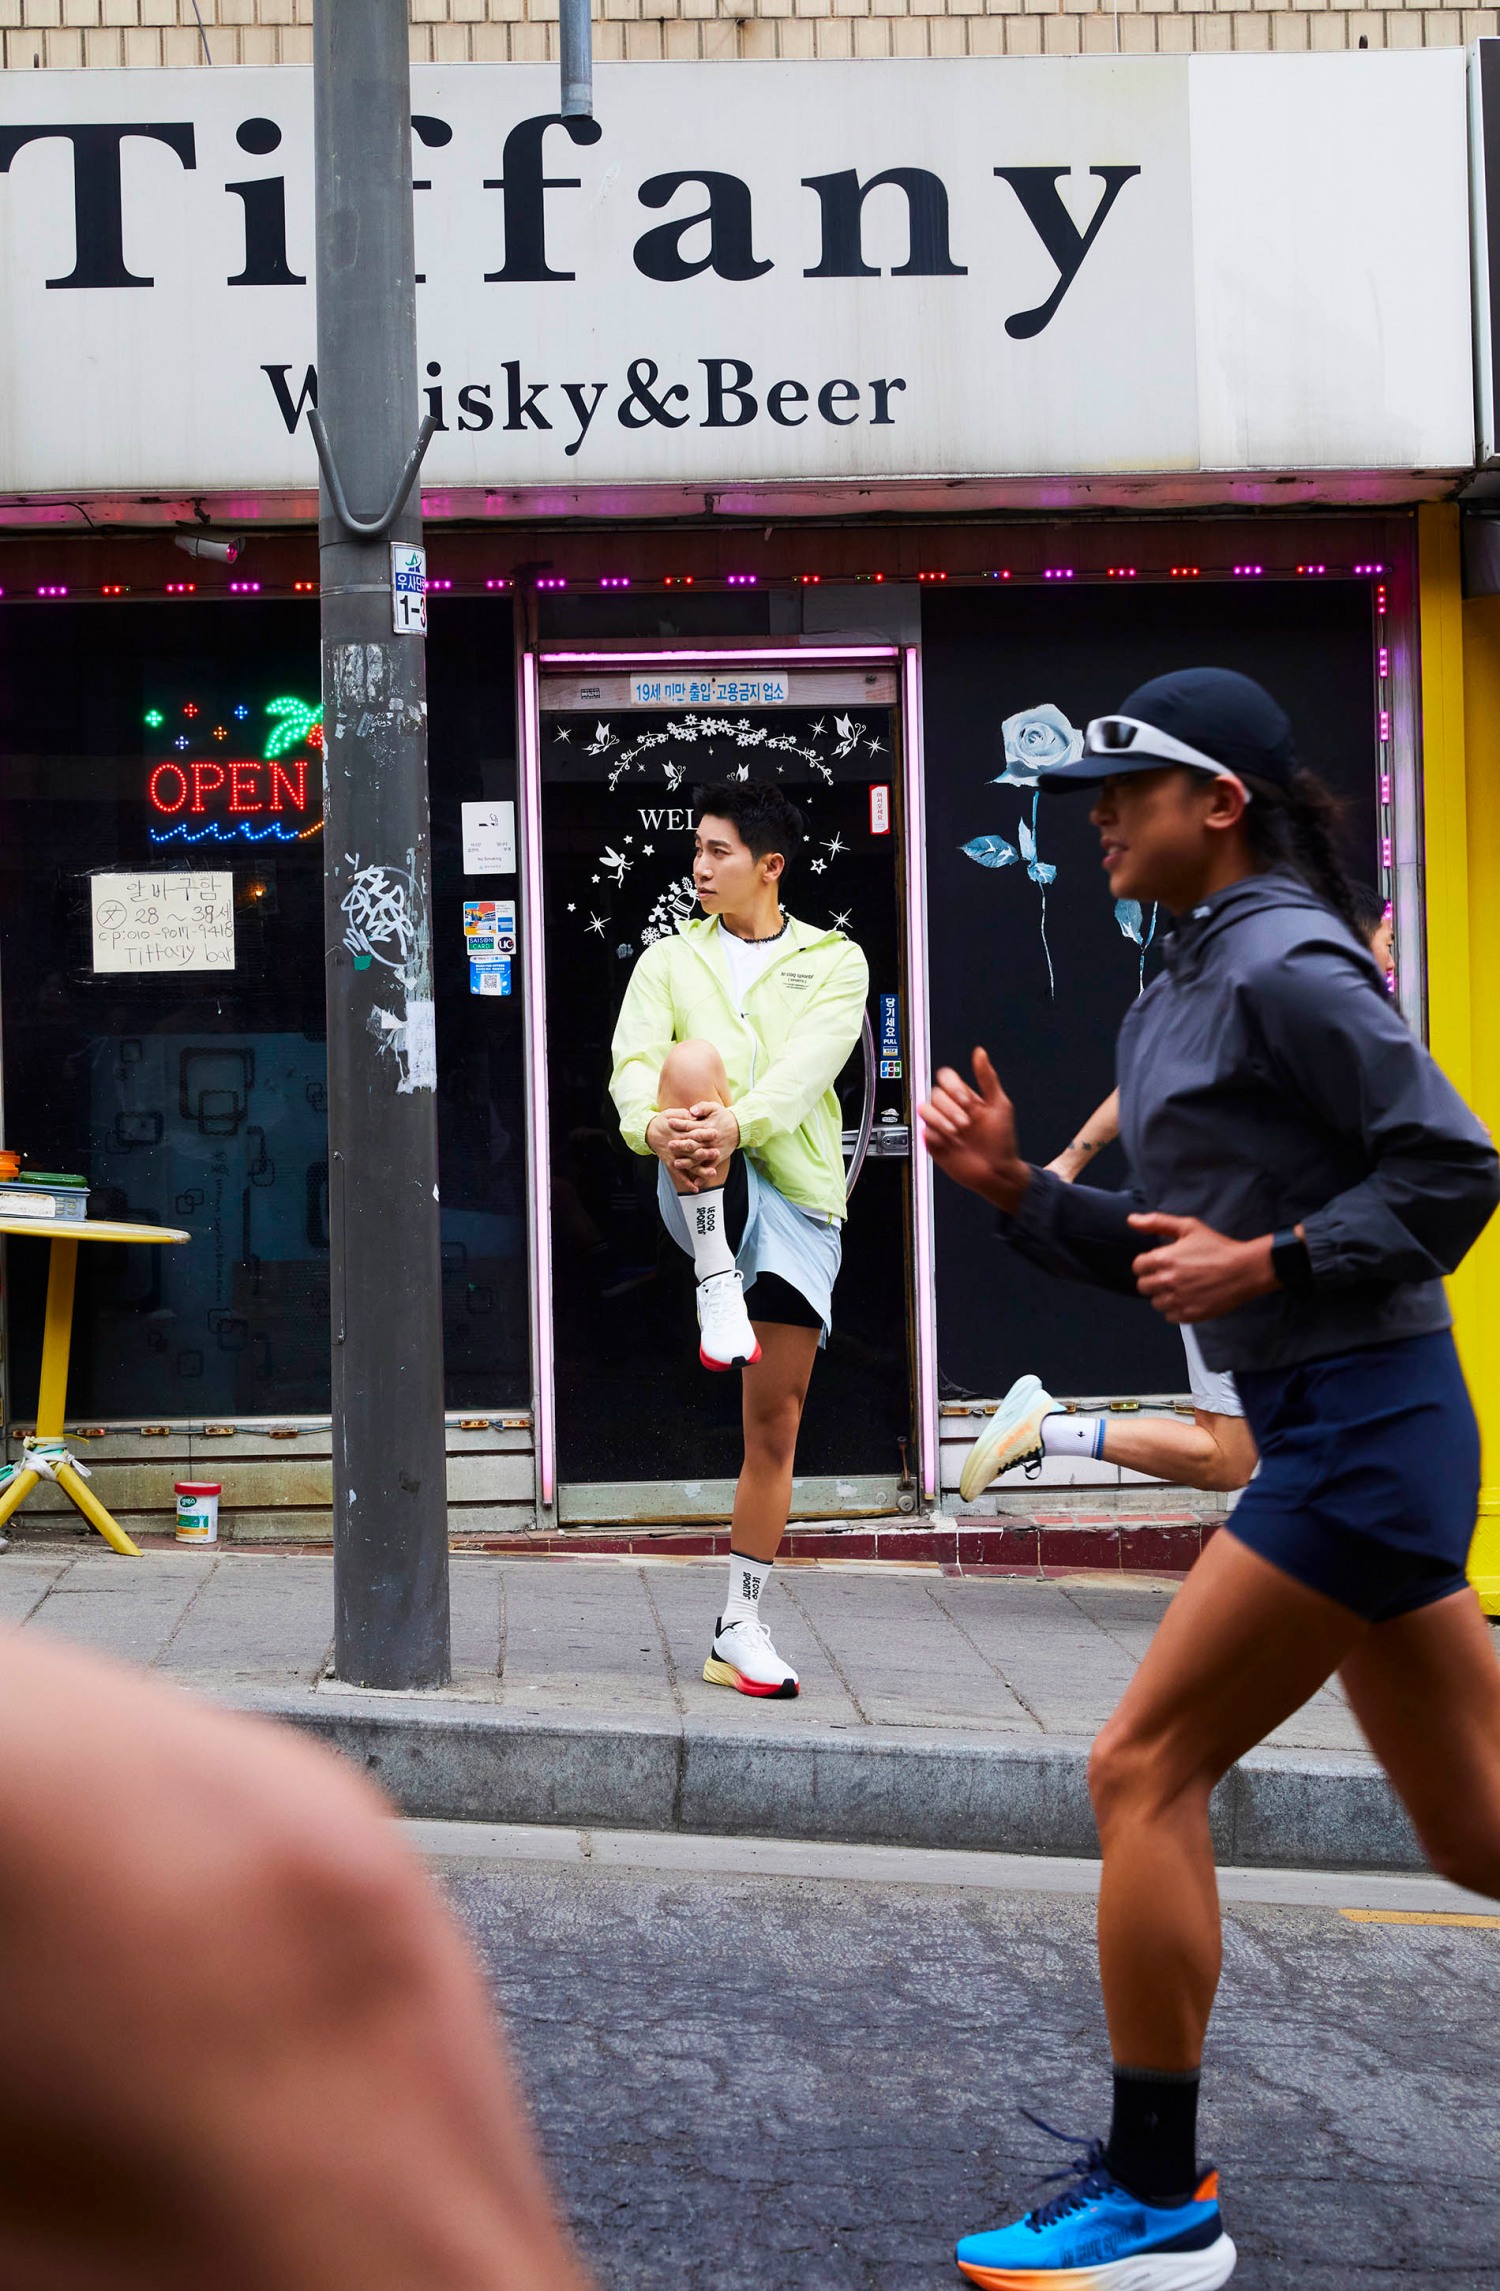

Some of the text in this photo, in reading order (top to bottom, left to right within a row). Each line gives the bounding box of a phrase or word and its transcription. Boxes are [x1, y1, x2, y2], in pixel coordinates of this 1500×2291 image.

[260, 357, 907, 456] Wisky&Beer
[636, 683, 661, 701] 19세
[664, 683, 686, 702] 미만
[763, 683, 784, 701] 업소
[150, 761, 310, 812] OPEN
[135, 907, 159, 925] 28
[205, 943, 234, 963] bar
[885, 997, 895, 1037] 당기세요
